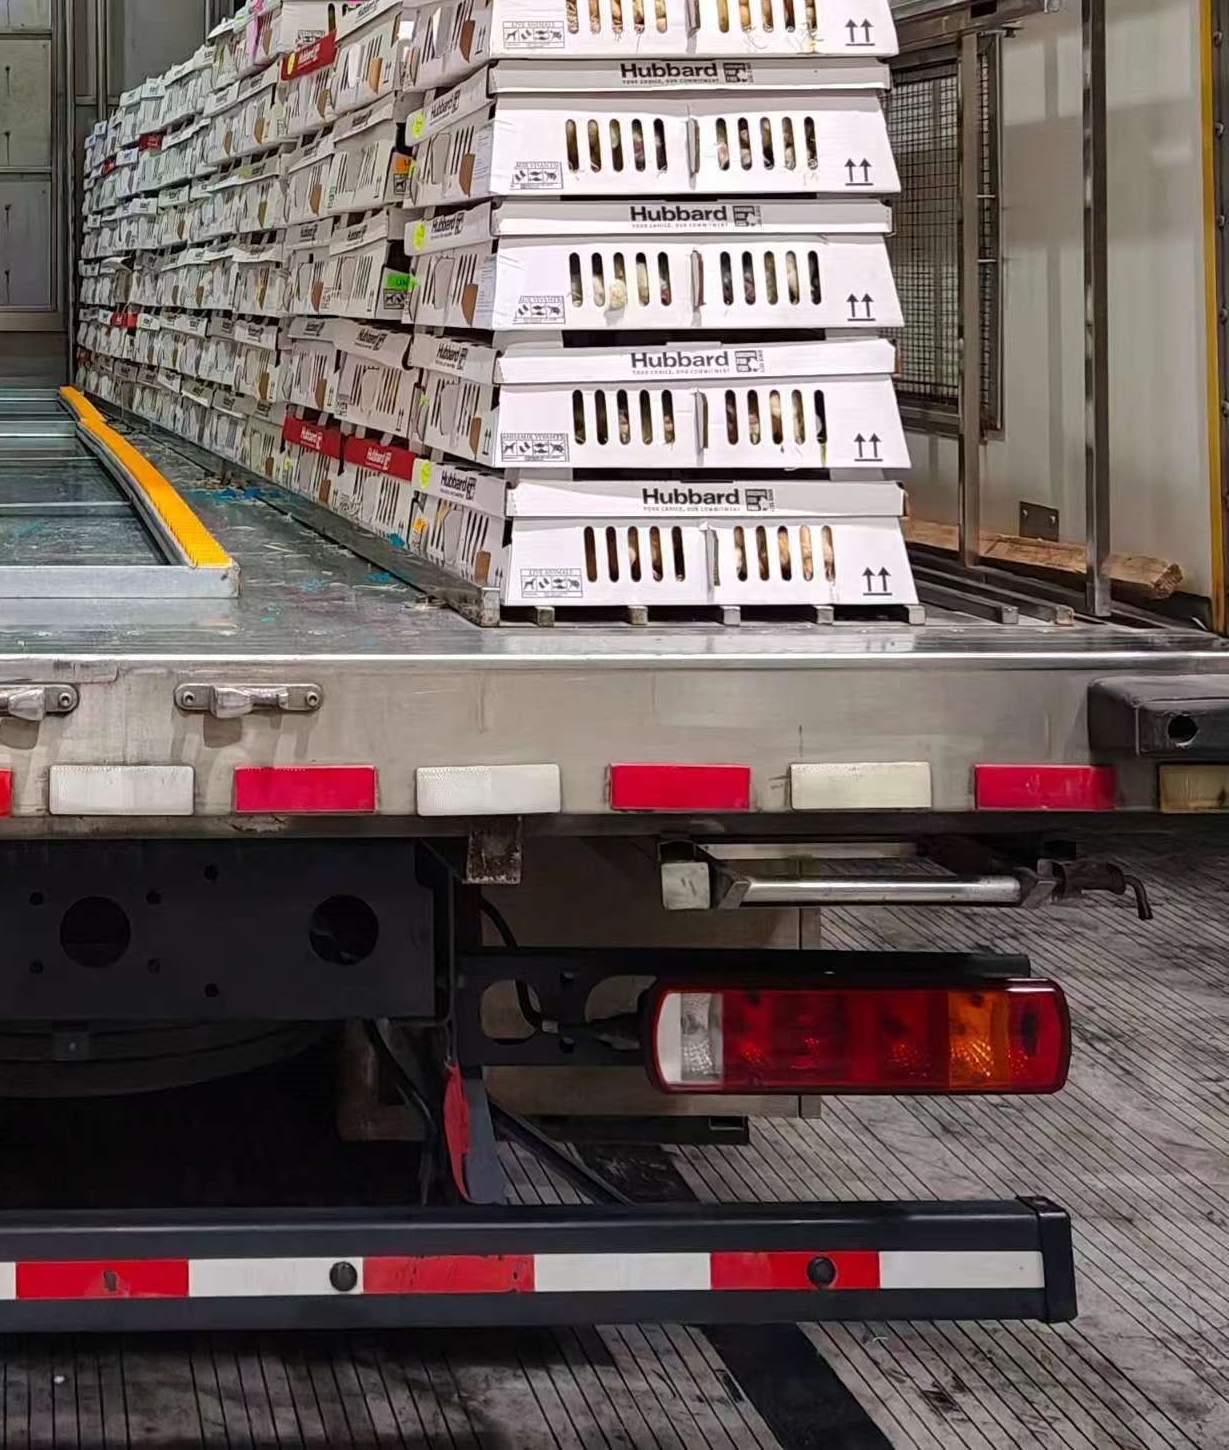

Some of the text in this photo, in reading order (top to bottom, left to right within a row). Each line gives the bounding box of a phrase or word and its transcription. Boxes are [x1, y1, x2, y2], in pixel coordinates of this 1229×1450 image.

[620, 62, 718, 78] Hubbard
[630, 205, 727, 221] Hubbard
[436, 342, 460, 362] Hubbard
[631, 351, 729, 368] Hubbard
[440, 470, 468, 492] Hubbard
[642, 488, 740, 504] Hubbard
